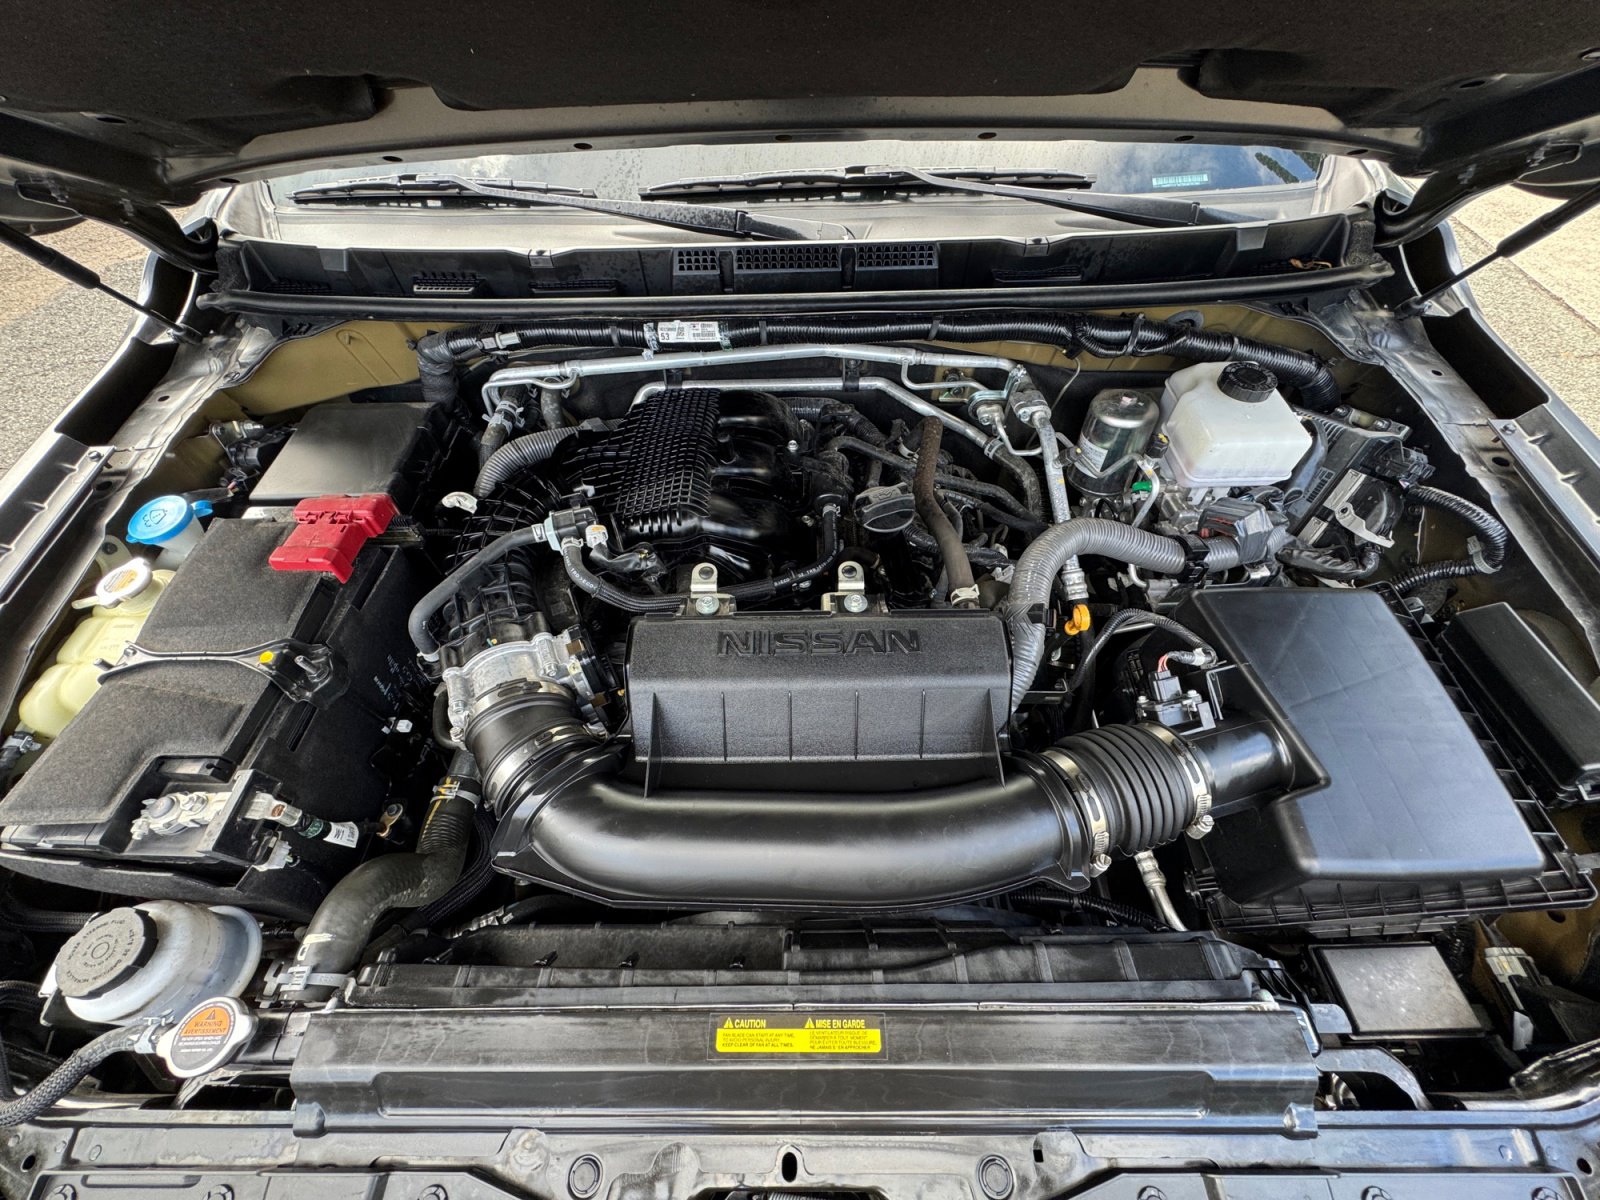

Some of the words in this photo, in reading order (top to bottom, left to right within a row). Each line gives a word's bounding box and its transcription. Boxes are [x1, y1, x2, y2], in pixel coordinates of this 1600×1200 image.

[660, 332, 670, 341] 53
[717, 628, 921, 656] NISSAN
[734, 1018, 767, 1029] CAUTION
[815, 1019, 832, 1029] MISE
[832, 1019, 842, 1029] EN
[842, 1019, 866, 1029] GARDE
